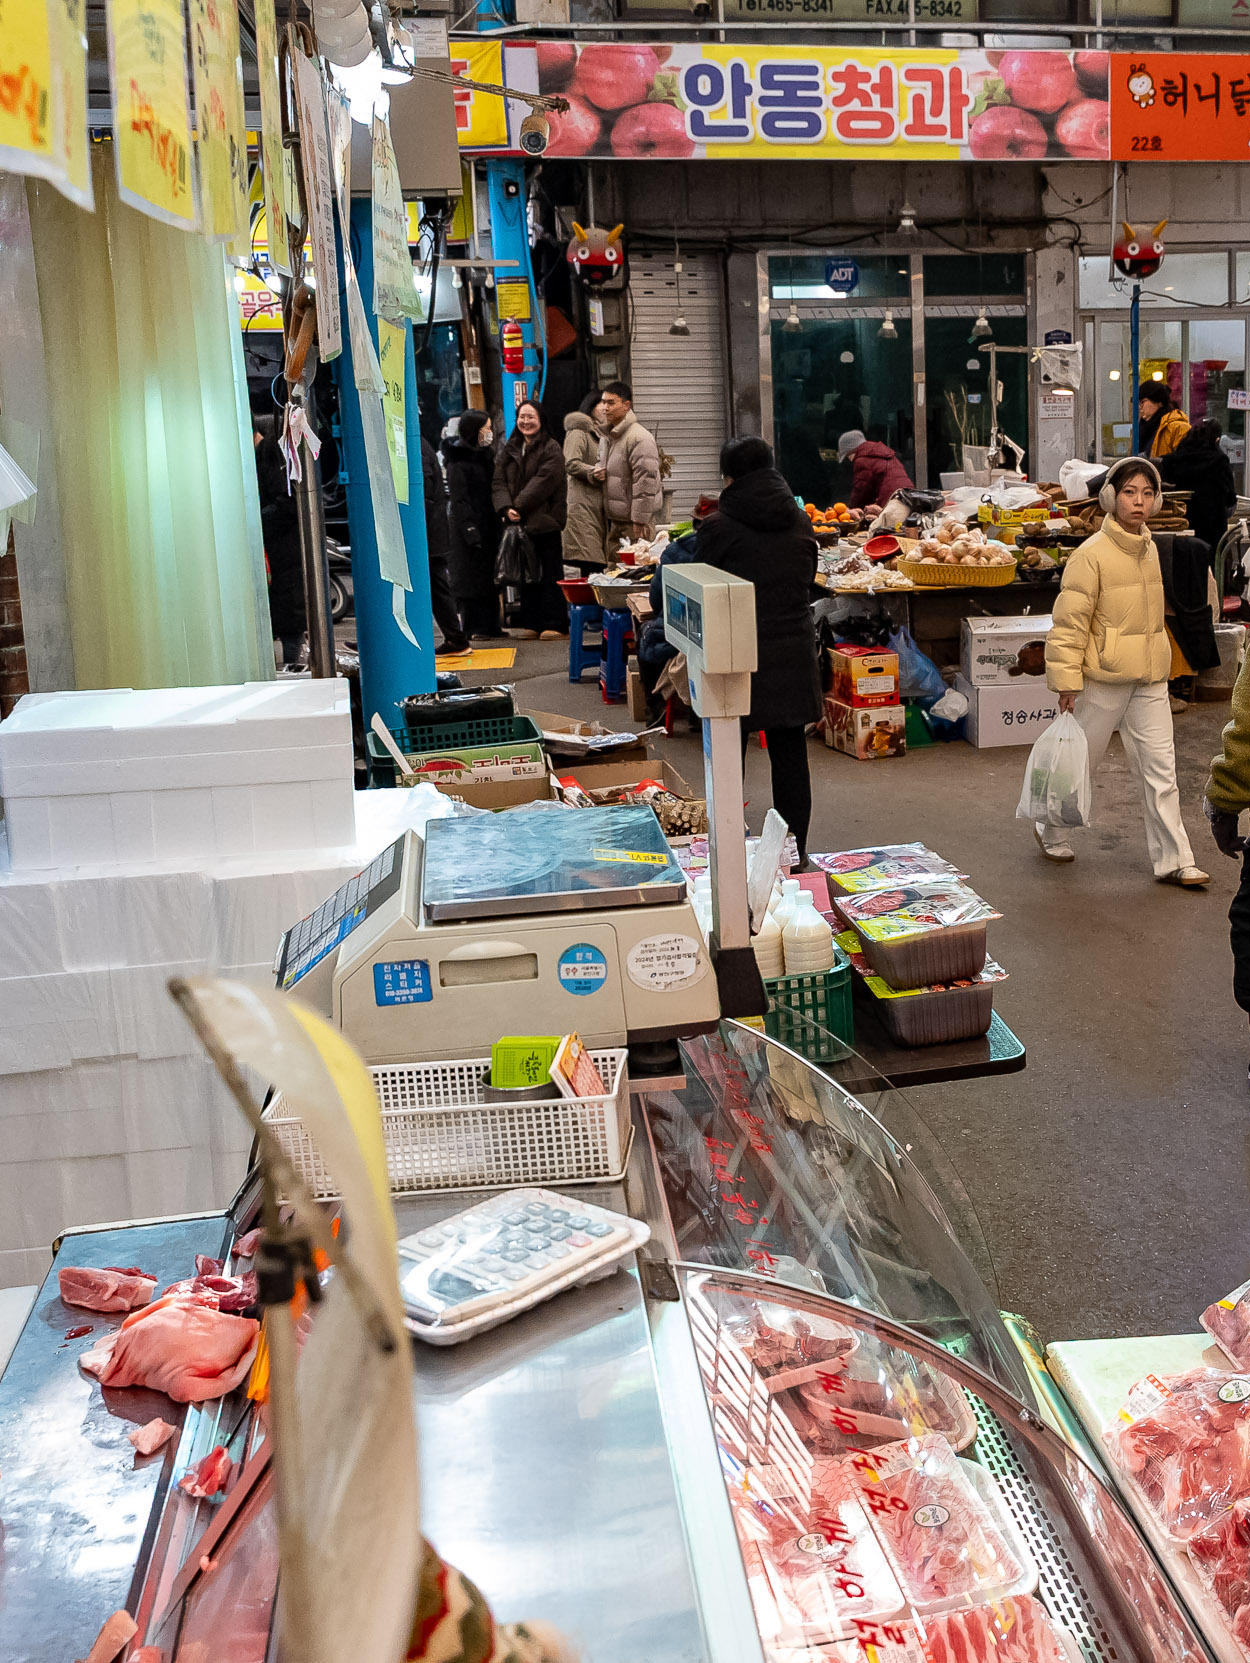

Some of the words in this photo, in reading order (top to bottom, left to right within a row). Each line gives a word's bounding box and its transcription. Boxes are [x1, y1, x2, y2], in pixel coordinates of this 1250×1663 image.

[866, 0, 962, 17] FAX.45-8342
[683, 61, 971, 140] 안동청과
[1131, 136, 1163, 152] 22호
[830, 267, 854, 281] ADT
[1002, 708, 1057, 726] 청송사과
